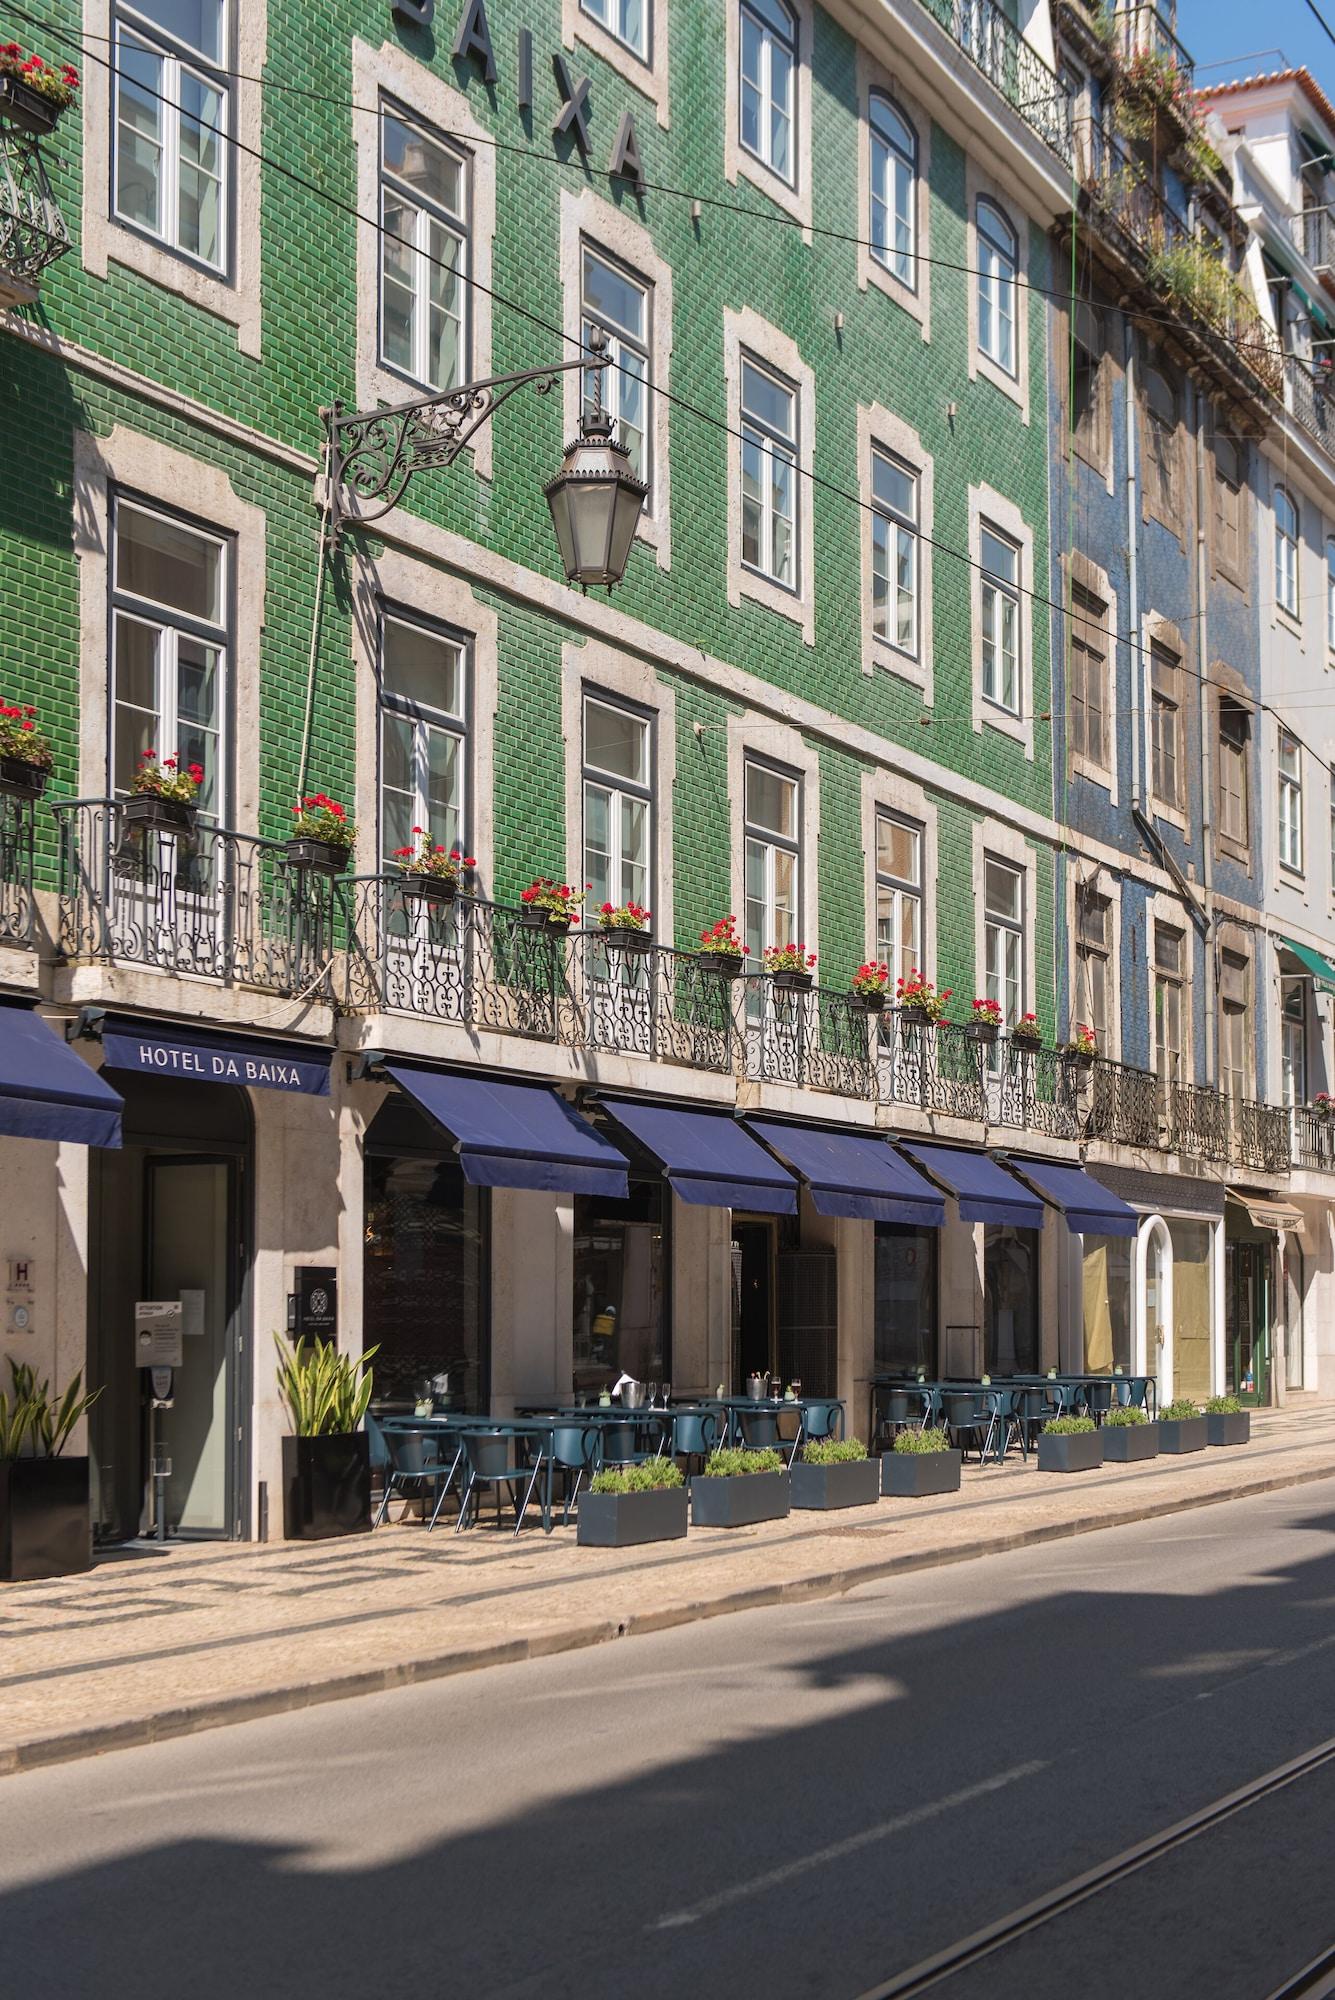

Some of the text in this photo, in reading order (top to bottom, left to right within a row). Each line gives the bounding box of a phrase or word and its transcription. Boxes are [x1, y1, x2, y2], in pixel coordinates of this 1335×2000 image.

[139, 1045, 301, 1086] HOTEL DA BAIXA
[16, 1263, 28, 1281] H
